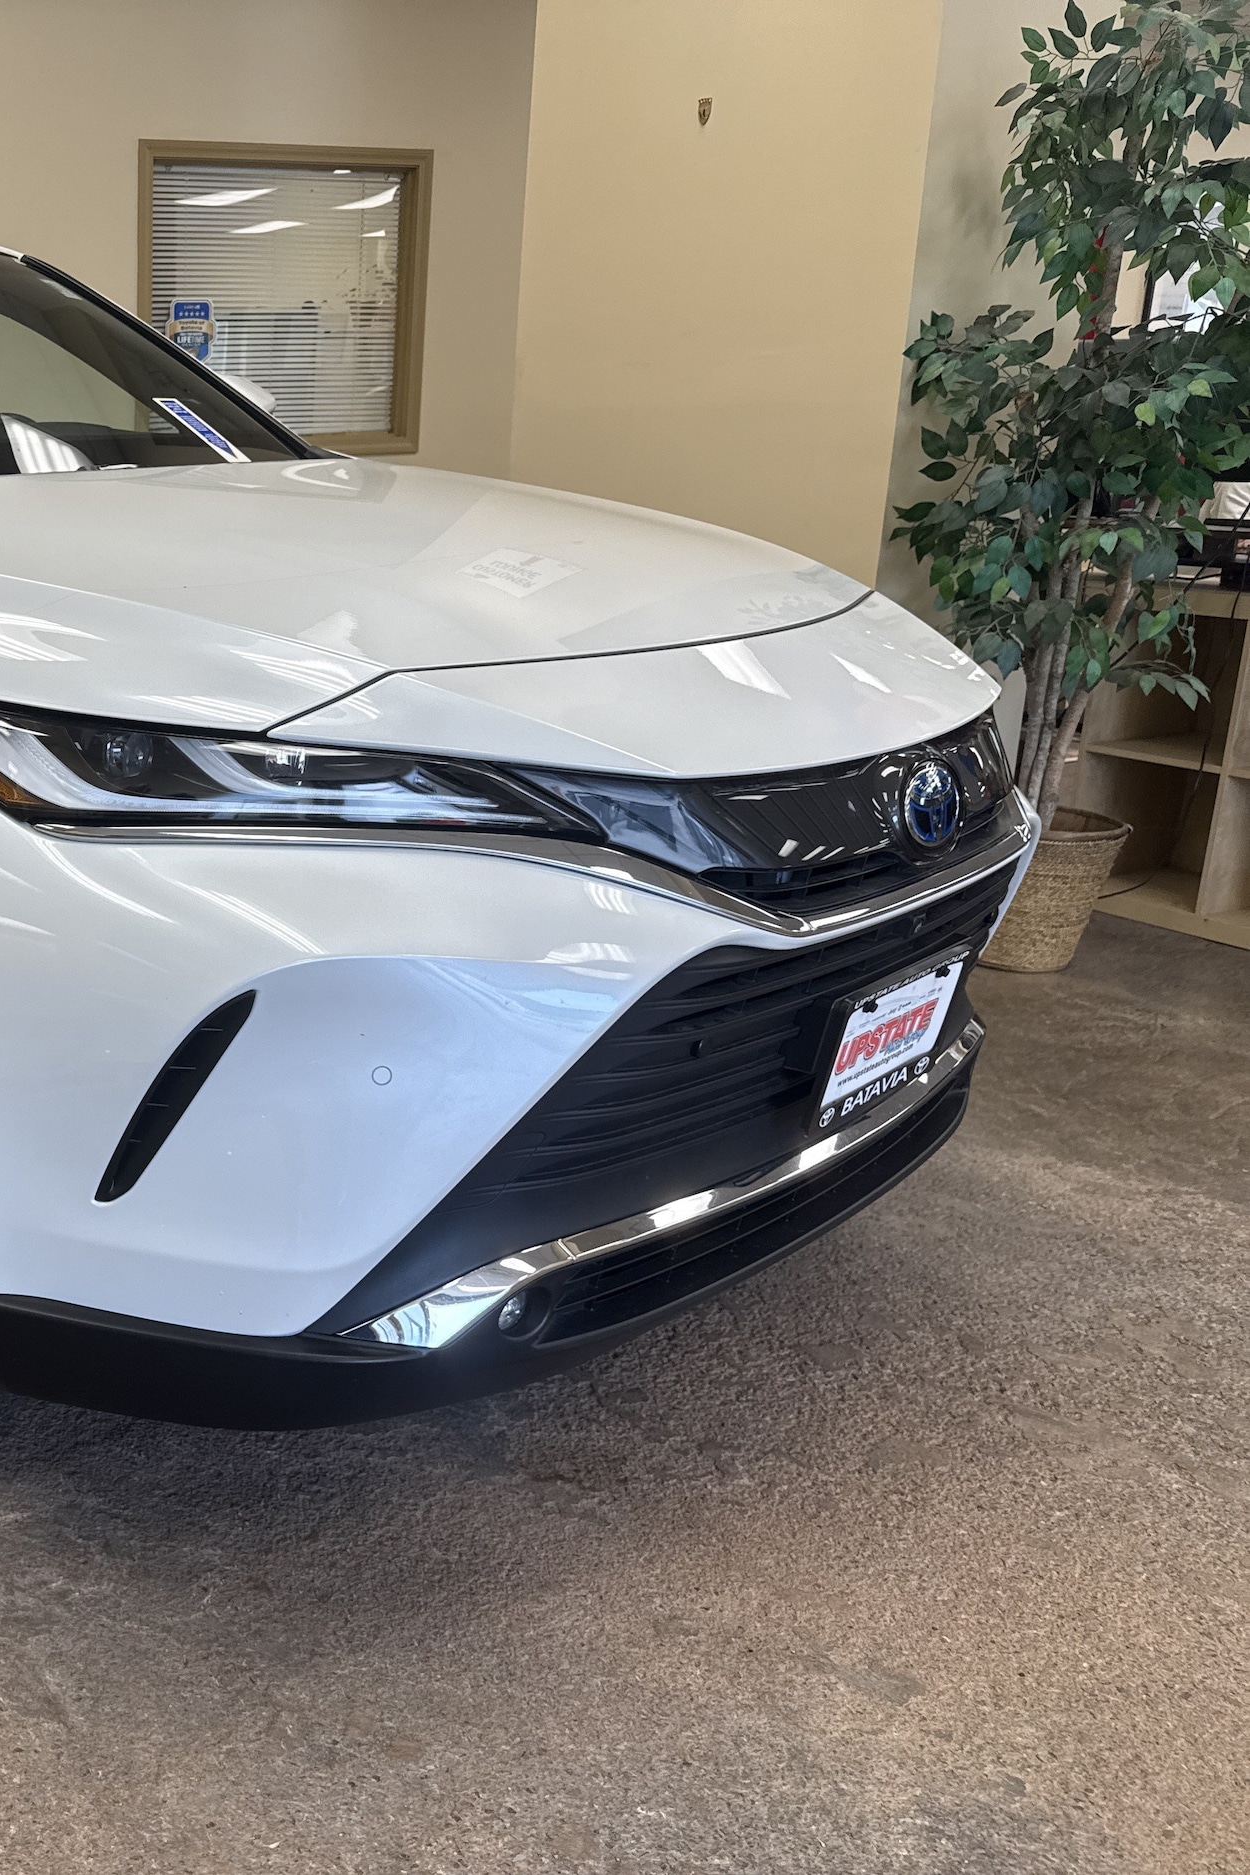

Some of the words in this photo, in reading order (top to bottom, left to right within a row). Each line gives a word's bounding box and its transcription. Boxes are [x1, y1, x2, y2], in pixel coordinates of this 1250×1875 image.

[900, 969, 931, 986] AUTO
[932, 950, 970, 972] GROUP
[834, 997, 940, 1076] UPSTATE
[837, 1043, 913, 1087] www.upstateautogroup.com
[840, 1066, 908, 1117] BATAVIA
